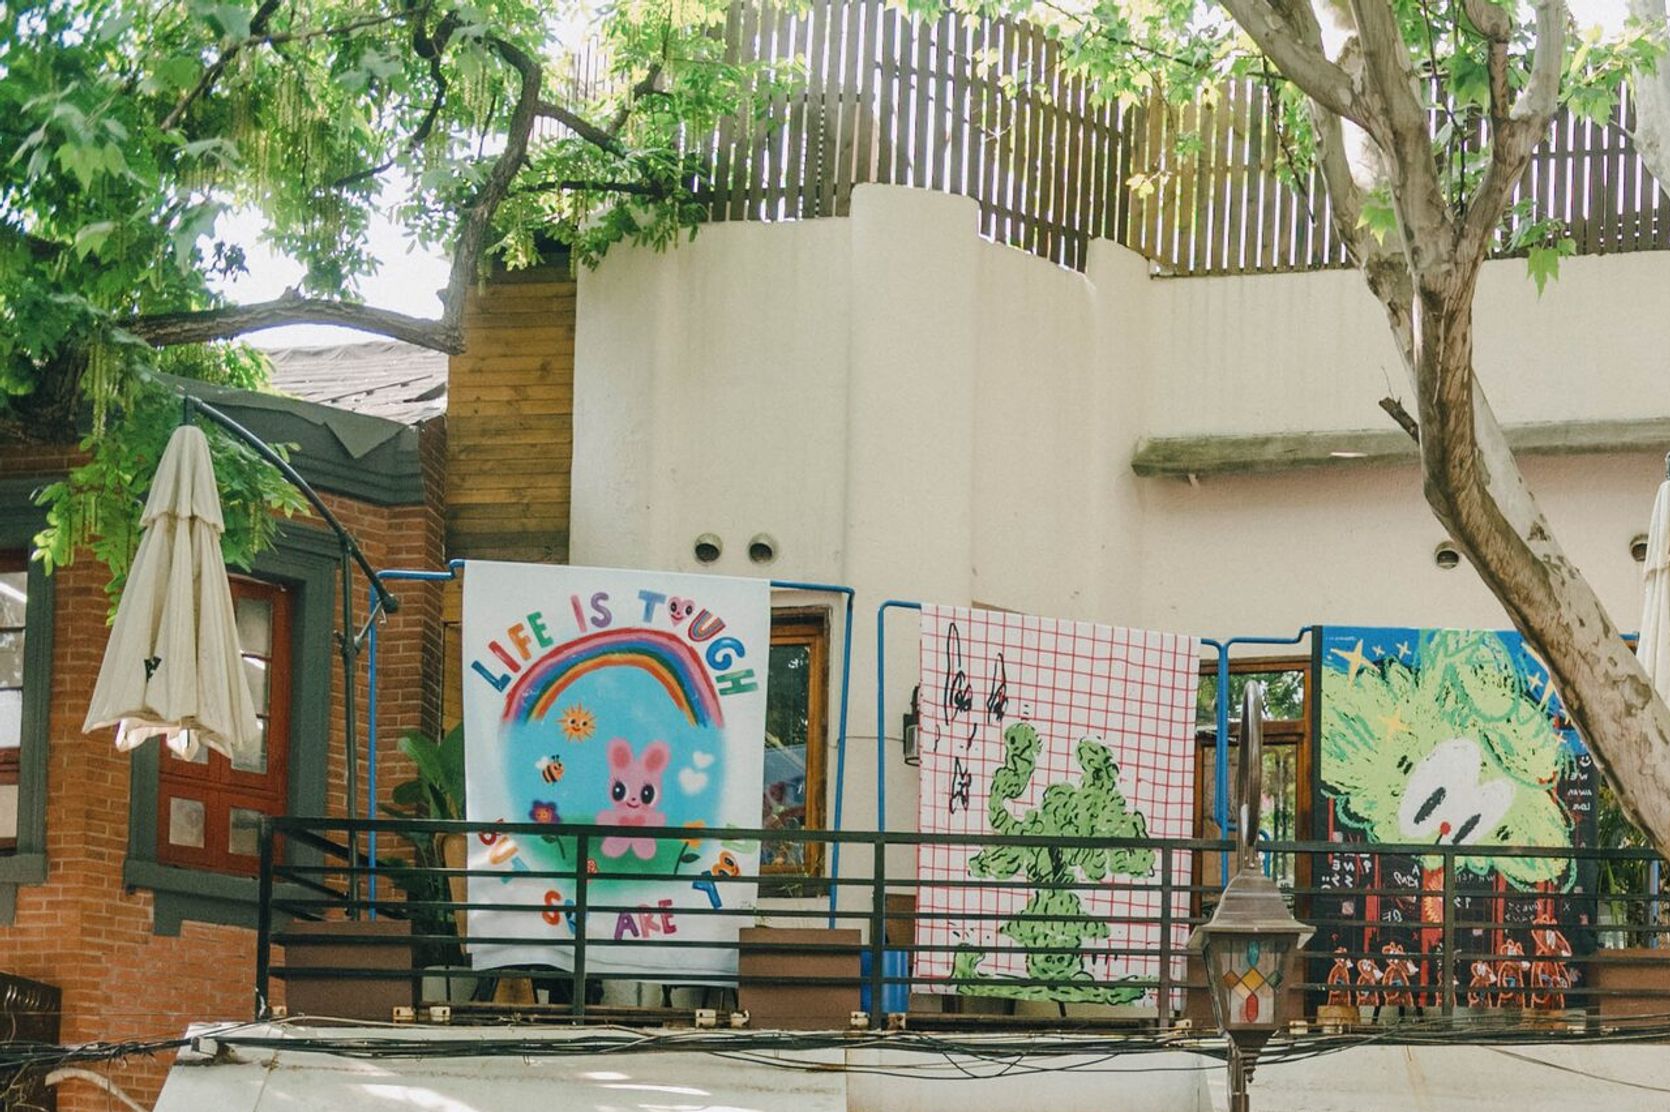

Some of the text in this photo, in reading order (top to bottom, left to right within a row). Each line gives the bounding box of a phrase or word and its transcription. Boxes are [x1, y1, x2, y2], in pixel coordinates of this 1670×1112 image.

[471, 611, 554, 692] LIFE
[571, 593, 612, 632] IS
[613, 899, 677, 940] ARE
